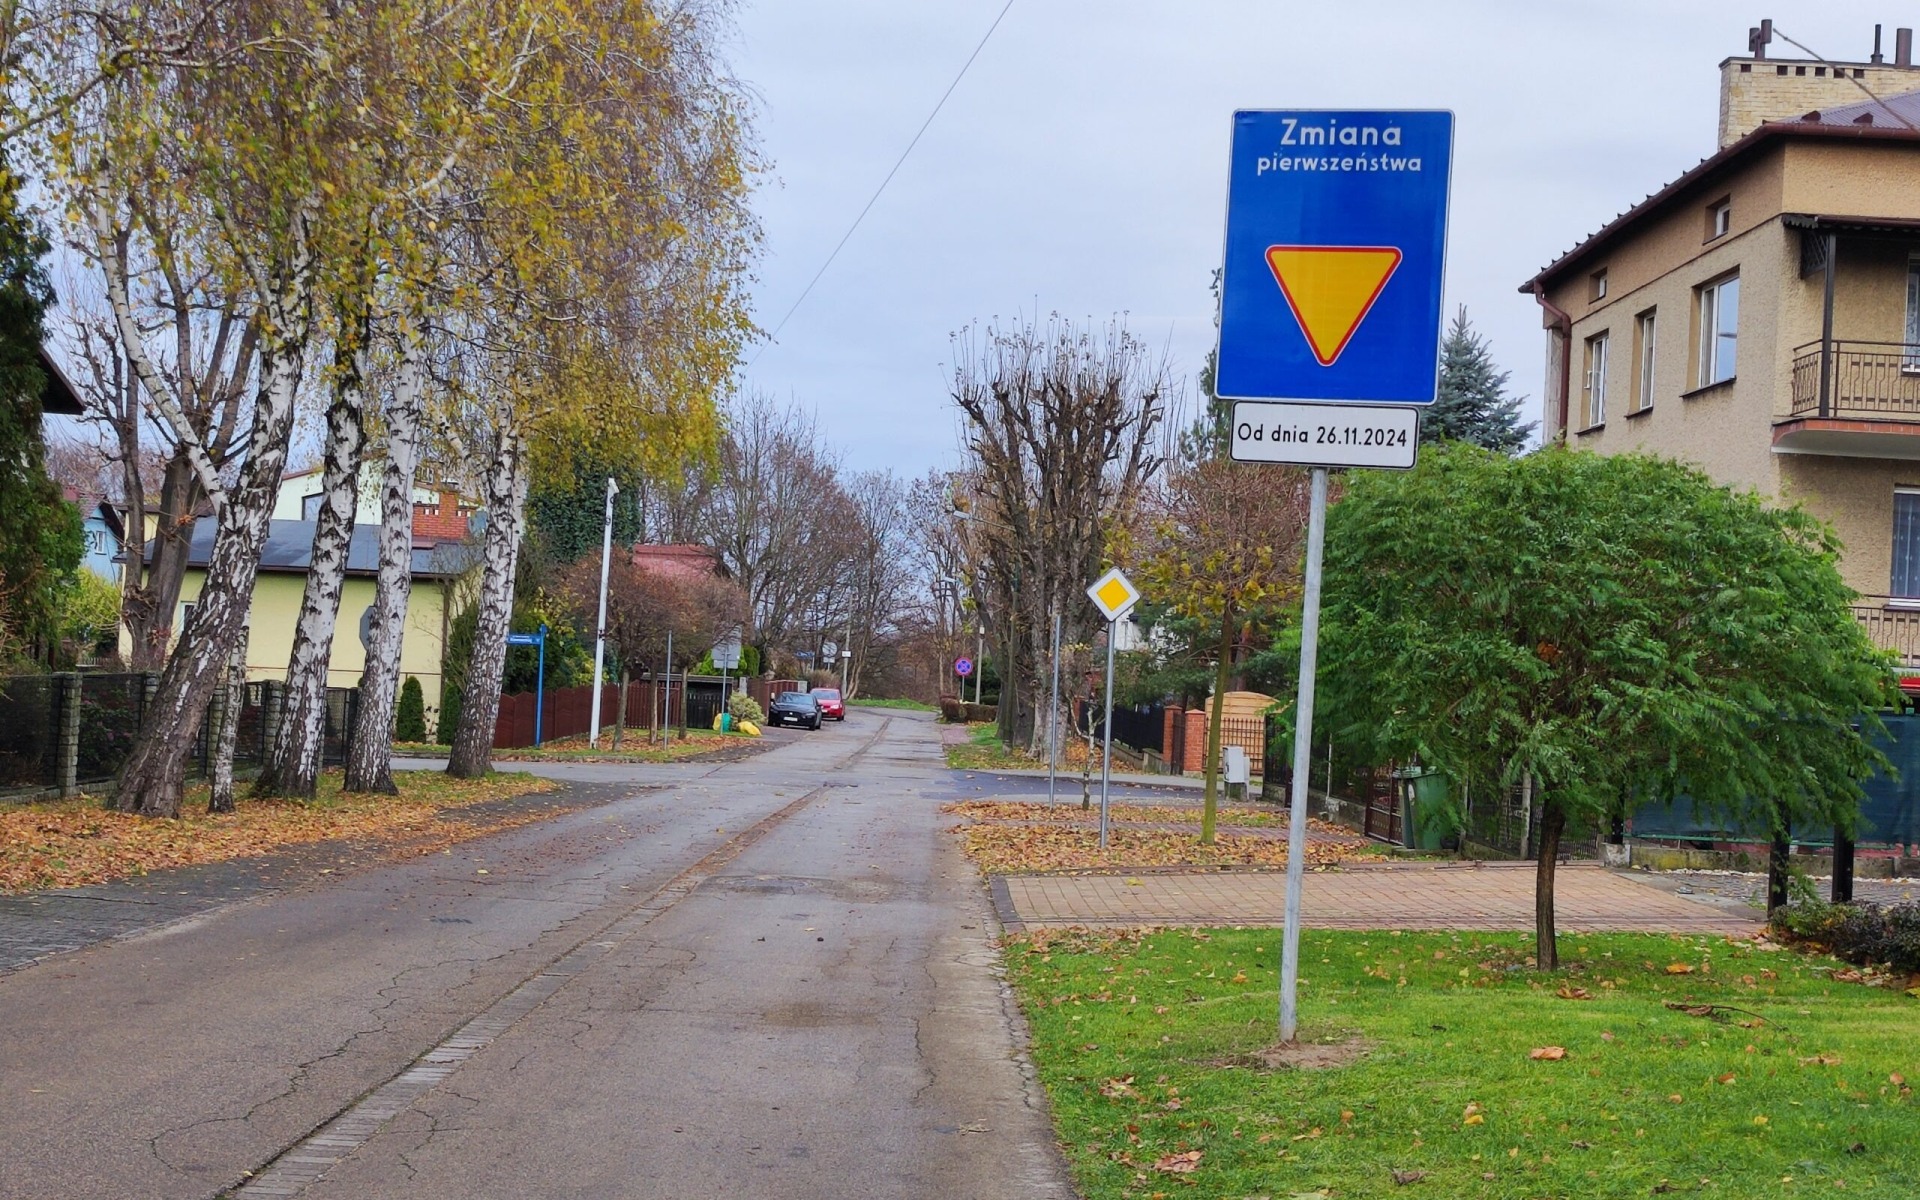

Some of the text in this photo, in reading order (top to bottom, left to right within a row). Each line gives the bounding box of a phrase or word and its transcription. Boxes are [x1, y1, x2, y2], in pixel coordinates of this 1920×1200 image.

[1281, 119, 1402, 146] Zmiana
[1257, 152, 1422, 176] pierwszeństwa
[1237, 422, 1407, 447] Od dnia 26.11.2024
